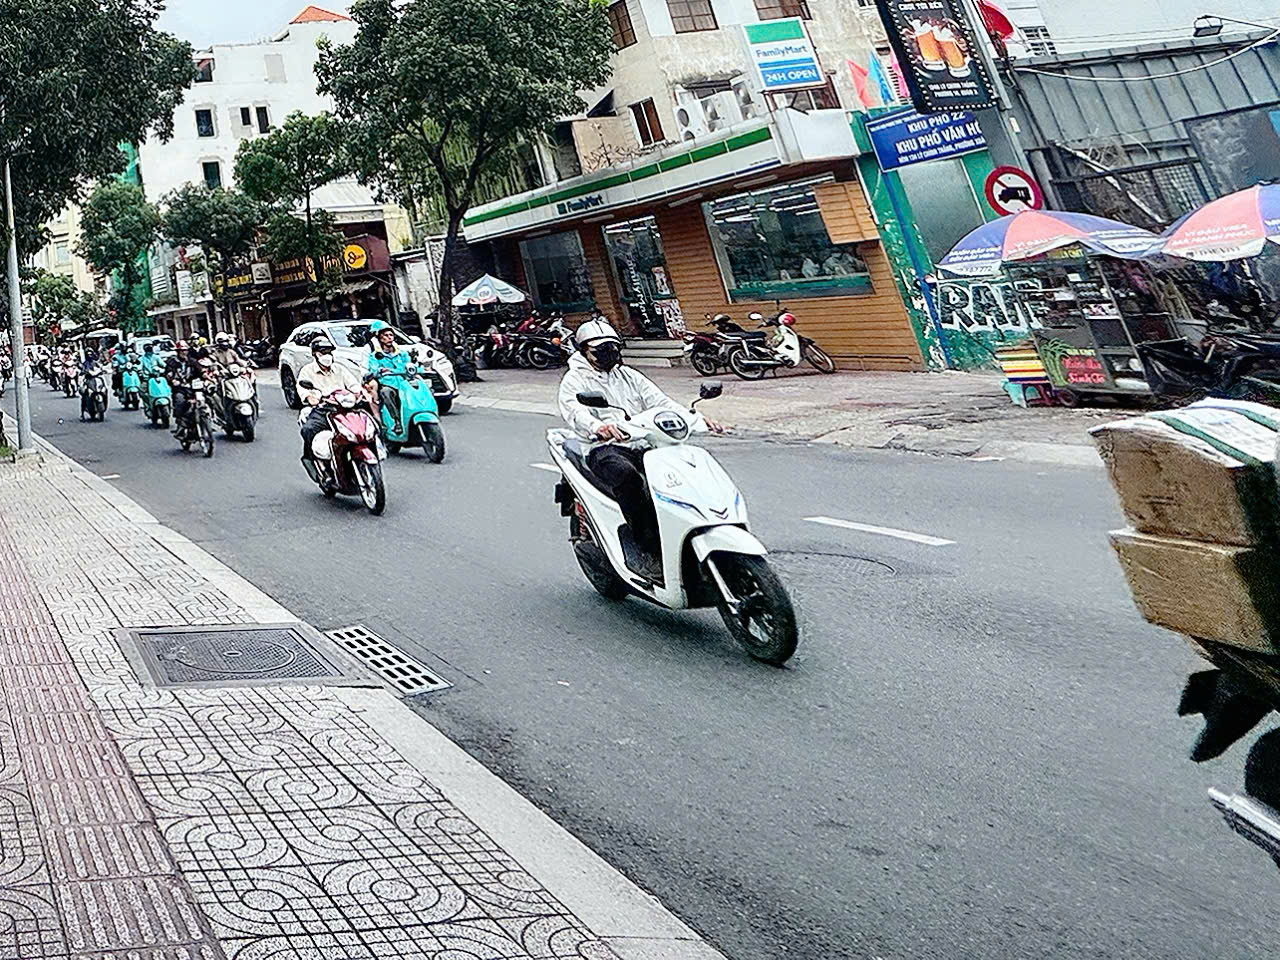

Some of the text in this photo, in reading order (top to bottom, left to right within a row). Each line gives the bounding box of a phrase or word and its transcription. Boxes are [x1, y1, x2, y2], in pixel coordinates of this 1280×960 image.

[755, 45, 808, 58] FamilyMart
[766, 69, 817, 83] 24H OPEN
[907, 120, 928, 134] KHU
[895, 139, 918, 154] KHU
[917, 128, 942, 149] PHỐ
[941, 124, 967, 143] VĂN
[625, 251, 651, 325] FamilyMart
